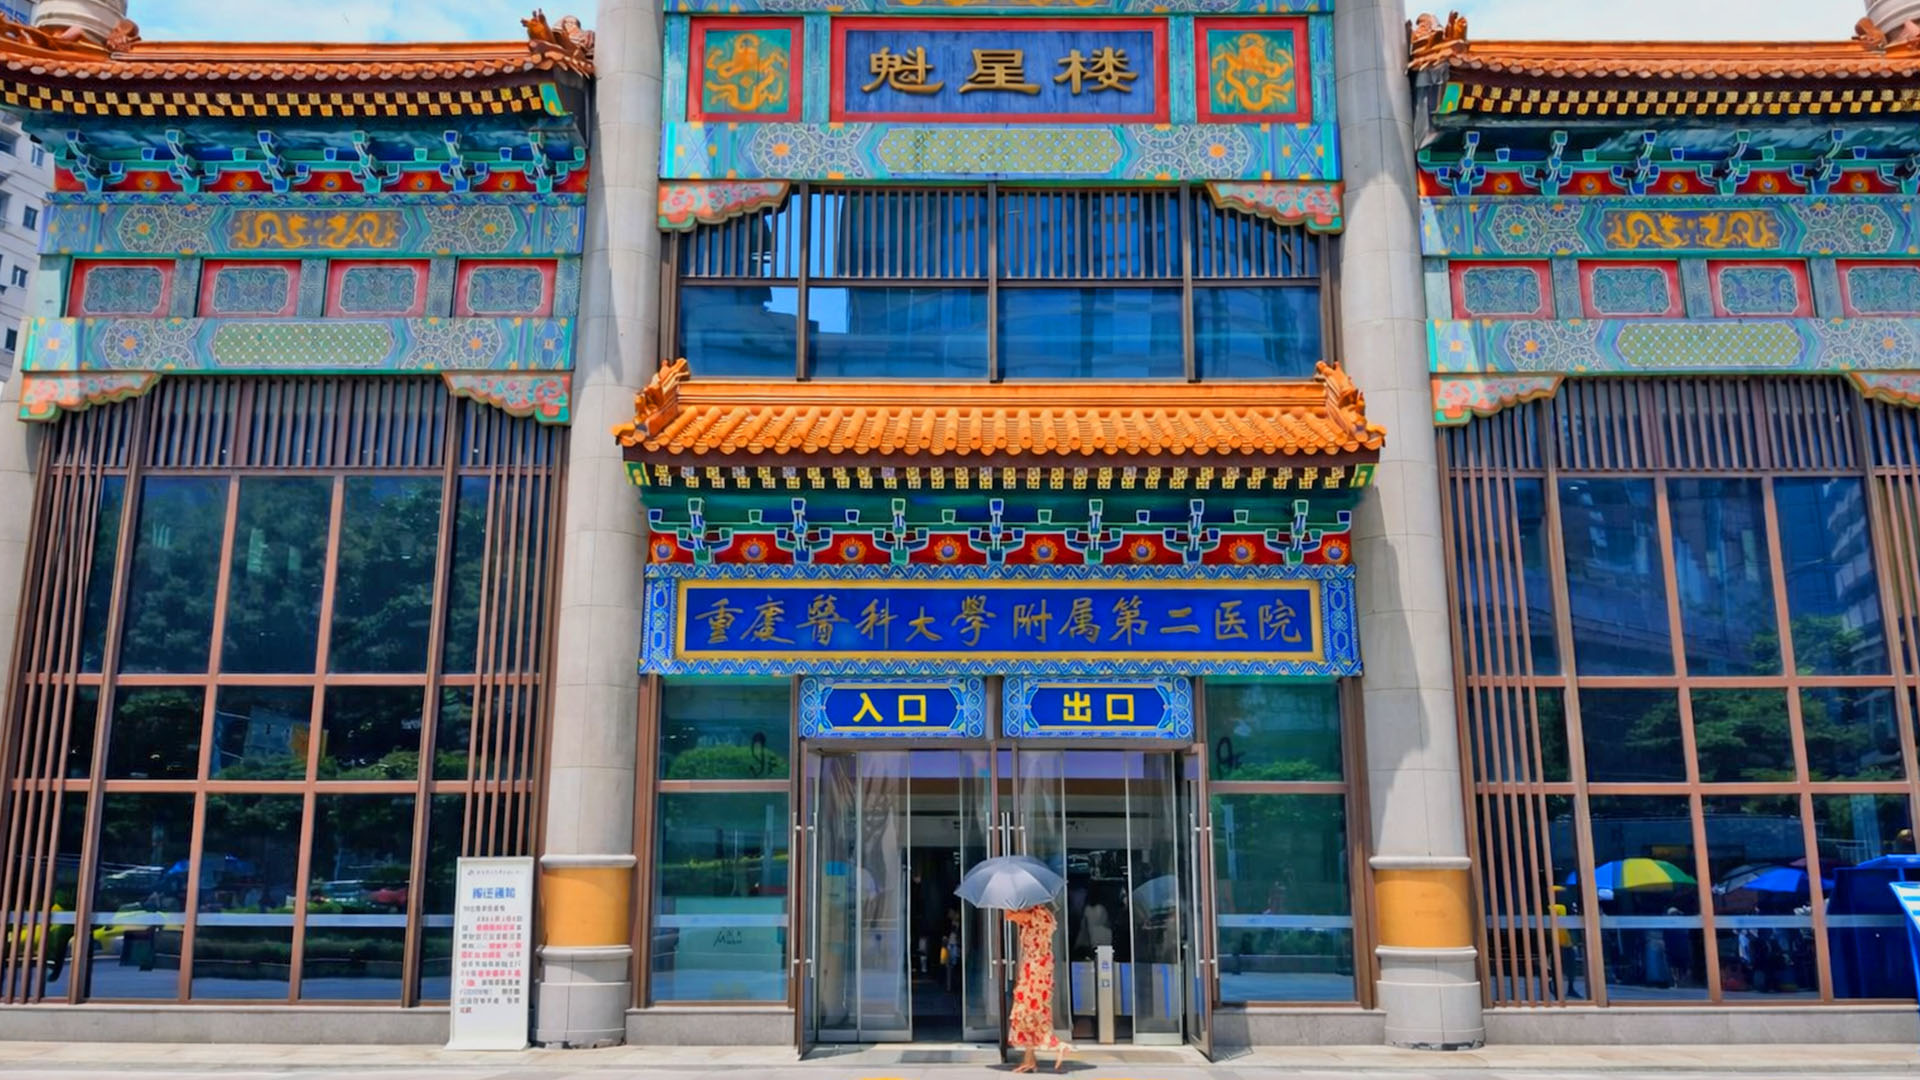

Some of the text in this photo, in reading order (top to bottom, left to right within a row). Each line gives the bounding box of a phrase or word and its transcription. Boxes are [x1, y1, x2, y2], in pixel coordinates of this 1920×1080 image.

[861, 46, 1138, 95] 魁星楼
[853, 692, 927, 722] 入口
[1063, 691, 1135, 722] 出口
